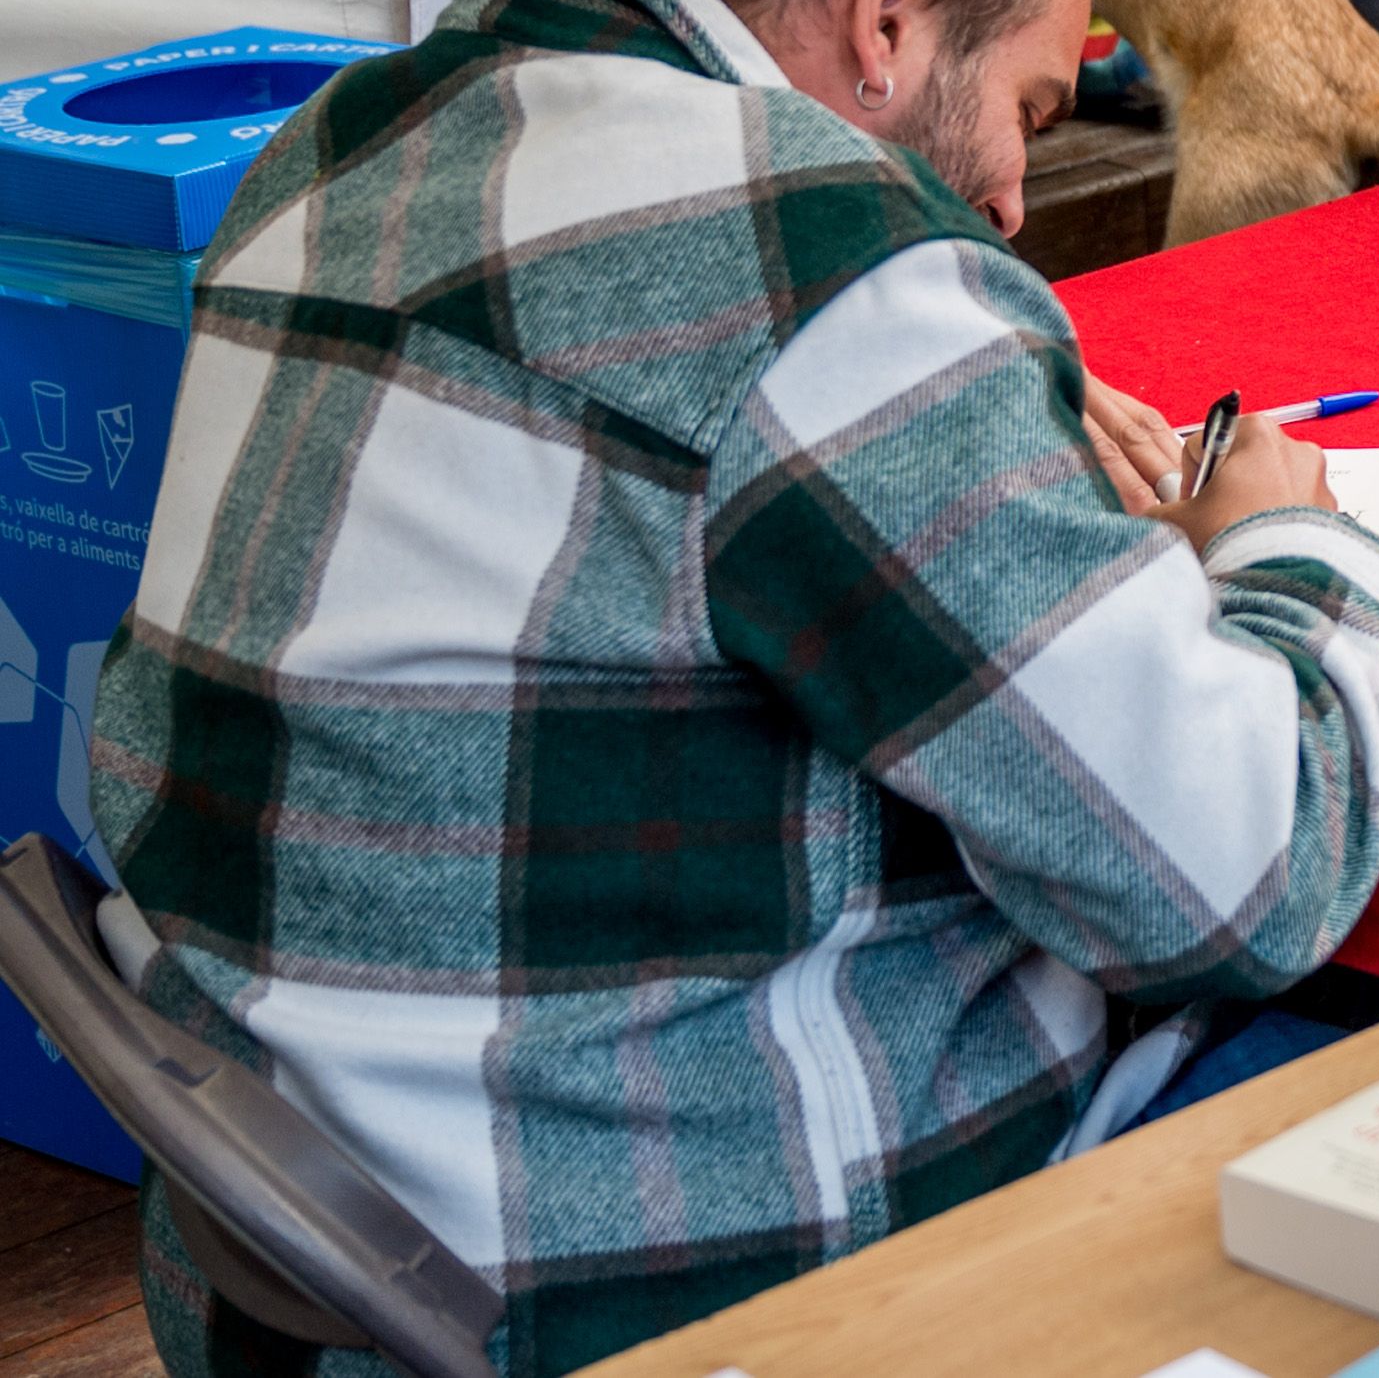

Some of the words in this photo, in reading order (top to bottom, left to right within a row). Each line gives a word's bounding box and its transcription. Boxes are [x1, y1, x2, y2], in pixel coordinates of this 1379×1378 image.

[102, 43, 237, 73] PAPER
[14, 497, 76, 527] vaixella
[79, 509, 99, 533] de
[27, 530, 54, 551] per
[57, 537, 67, 553] a
[71, 537, 141, 571] aliments
